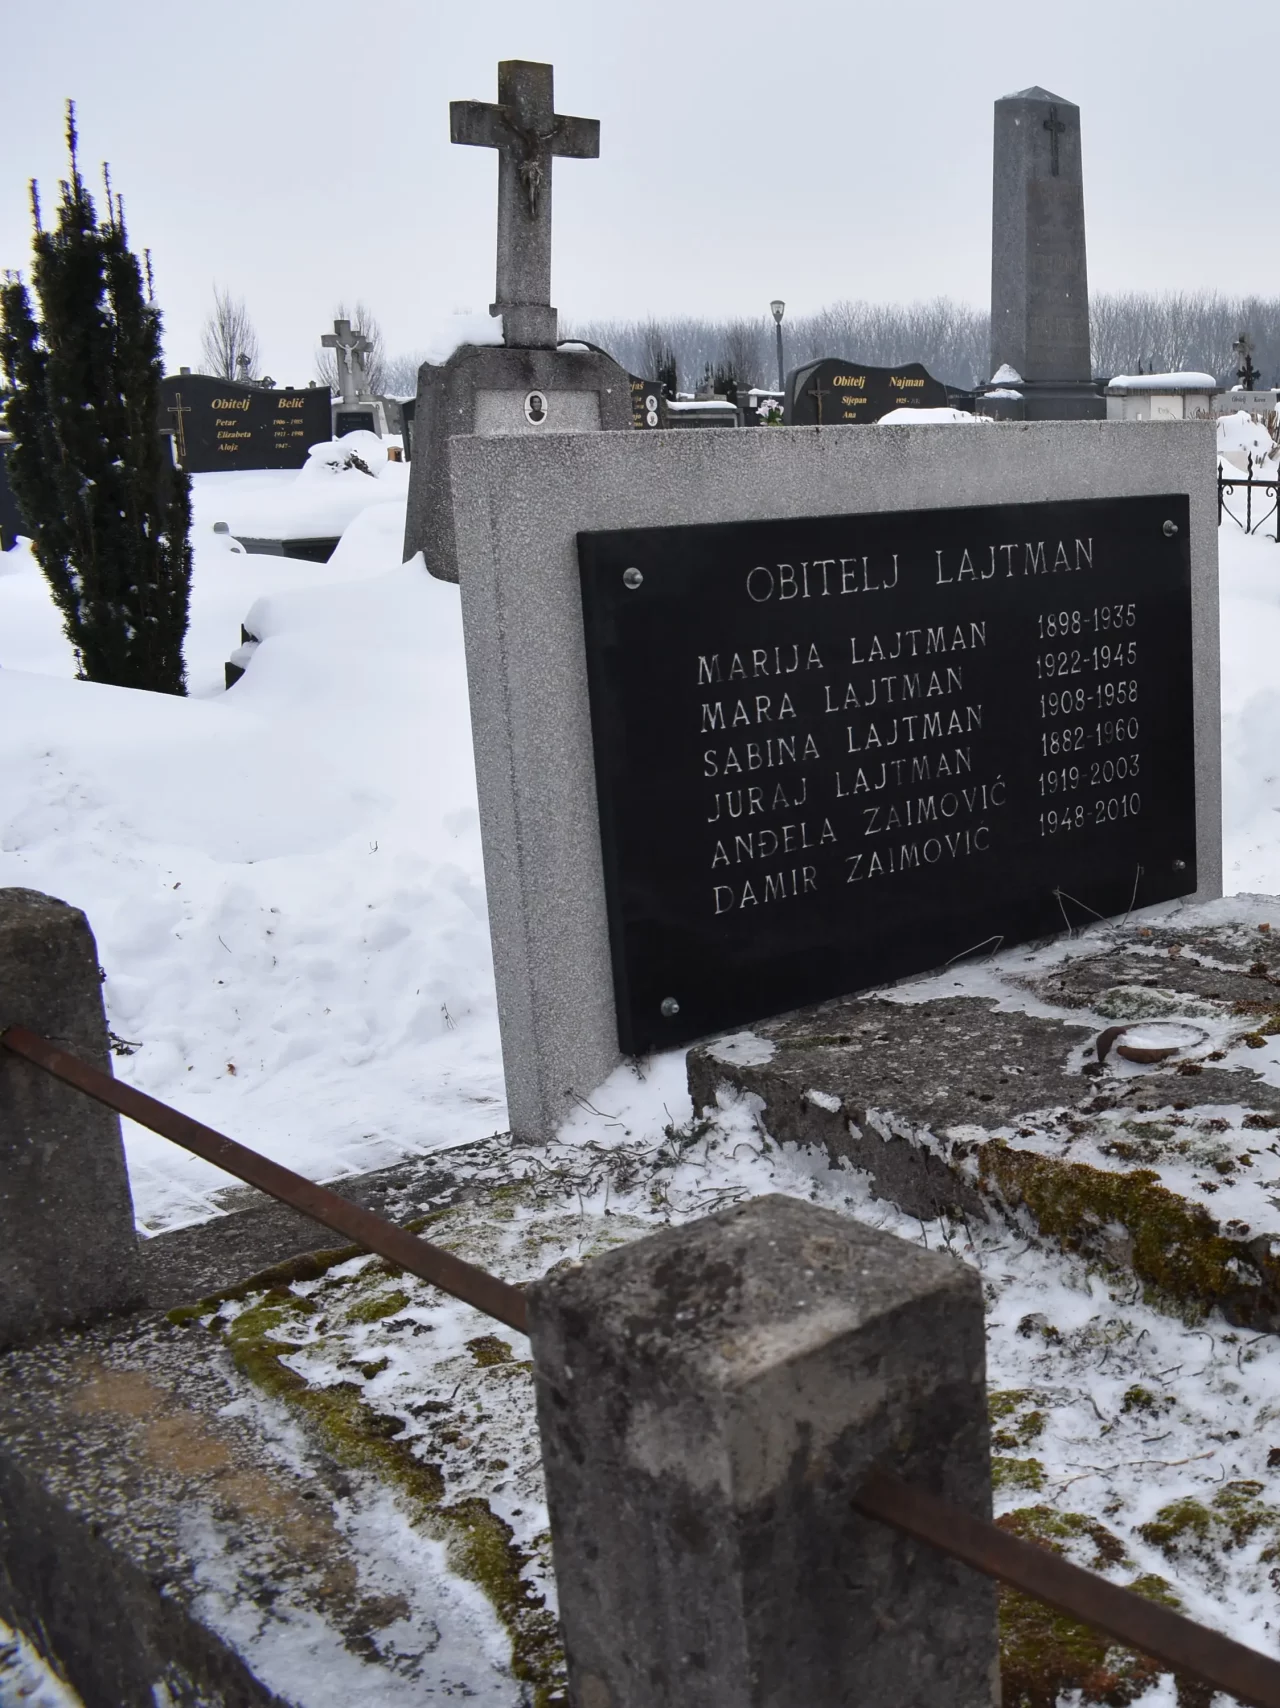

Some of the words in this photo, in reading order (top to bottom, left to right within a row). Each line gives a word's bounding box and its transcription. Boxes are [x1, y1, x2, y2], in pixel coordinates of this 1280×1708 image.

[211, 397, 251, 412] Obitelj
[278, 398, 304, 409] Belić
[630, 381, 644, 391] jaš
[833, 376, 866, 389] Obitelj
[889, 376, 925, 389] Najman
[216, 419, 237, 427] Petar
[217, 430, 252, 440] Elizabeta
[747, 554, 898, 602] OBITELJ
[936, 538, 1094, 584] LAJTMAN
[697, 643, 823, 685] MARIJA
[850, 621, 987, 665] LAJTMAN
[1038, 603, 1136, 639] 1898-1935
[701, 692, 797, 733] MARA
[825, 666, 962, 713] LAJTMAN
[1036, 641, 1137, 679] 1922-1945
[704, 733, 820, 777] SABINA
[847, 704, 982, 753] LAJTMAN
[1040, 680, 1138, 718] 1908-1958
[708, 778, 807, 823] JURAJ
[835, 747, 972, 798] LAJTMAN
[1041, 716, 1139, 757] 1882-1960
[711, 818, 838, 869] ANĐELA
[863, 774, 1007, 836] ZAIMOVIĆ
[1038, 753, 1140, 796] 1919-2003
[713, 866, 818, 915] DAMIR
[845, 820, 990, 883] ZAIMOVIĆ
[1039, 792, 1140, 837] 1948-2010
